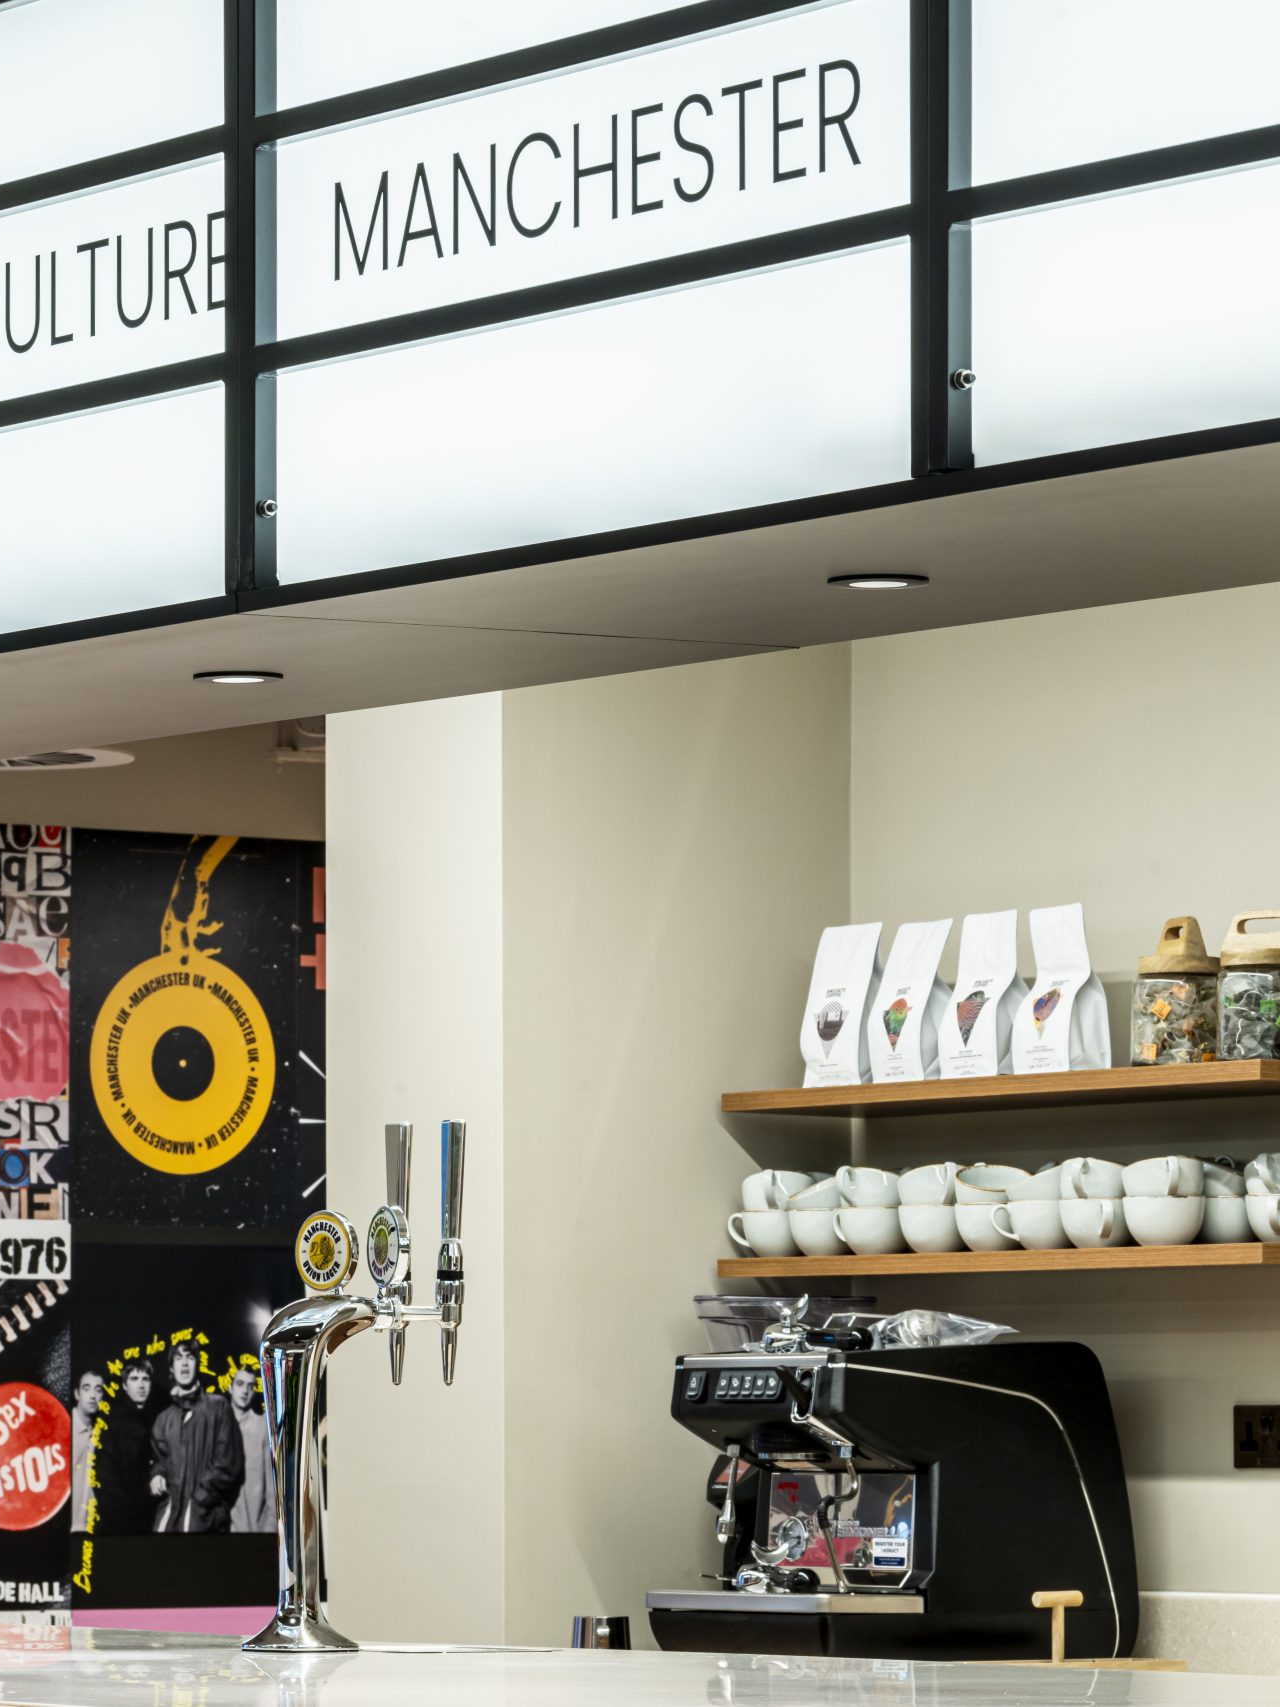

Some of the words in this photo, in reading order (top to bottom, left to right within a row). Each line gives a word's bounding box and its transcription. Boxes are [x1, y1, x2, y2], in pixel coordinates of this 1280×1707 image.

[334, 59, 862, 281] MANCHESTER
[129, 972, 190, 1008] MANCHESTER
[193, 974, 206, 990] UK
[211, 982, 257, 1046] MANCHESTER
[247, 1048, 259, 1063] UK
[107, 1024, 124, 1102] MANCHESTER
[116, 1007, 131, 1025] UK
[122, 1108, 137, 1126] UK
[218, 1076, 259, 1141] MANCHESTER
[133, 1121, 196, 1155] MANCHESTER
[204, 1134, 219, 1150] UK
[303, 1221, 341, 1244] MANCHESTER
[303, 1260, 321, 1282] UNION
[323, 1261, 341, 1282] LAGER
[146, 1333, 166, 1356] who
[18, 1581, 64, 1603] HALL
